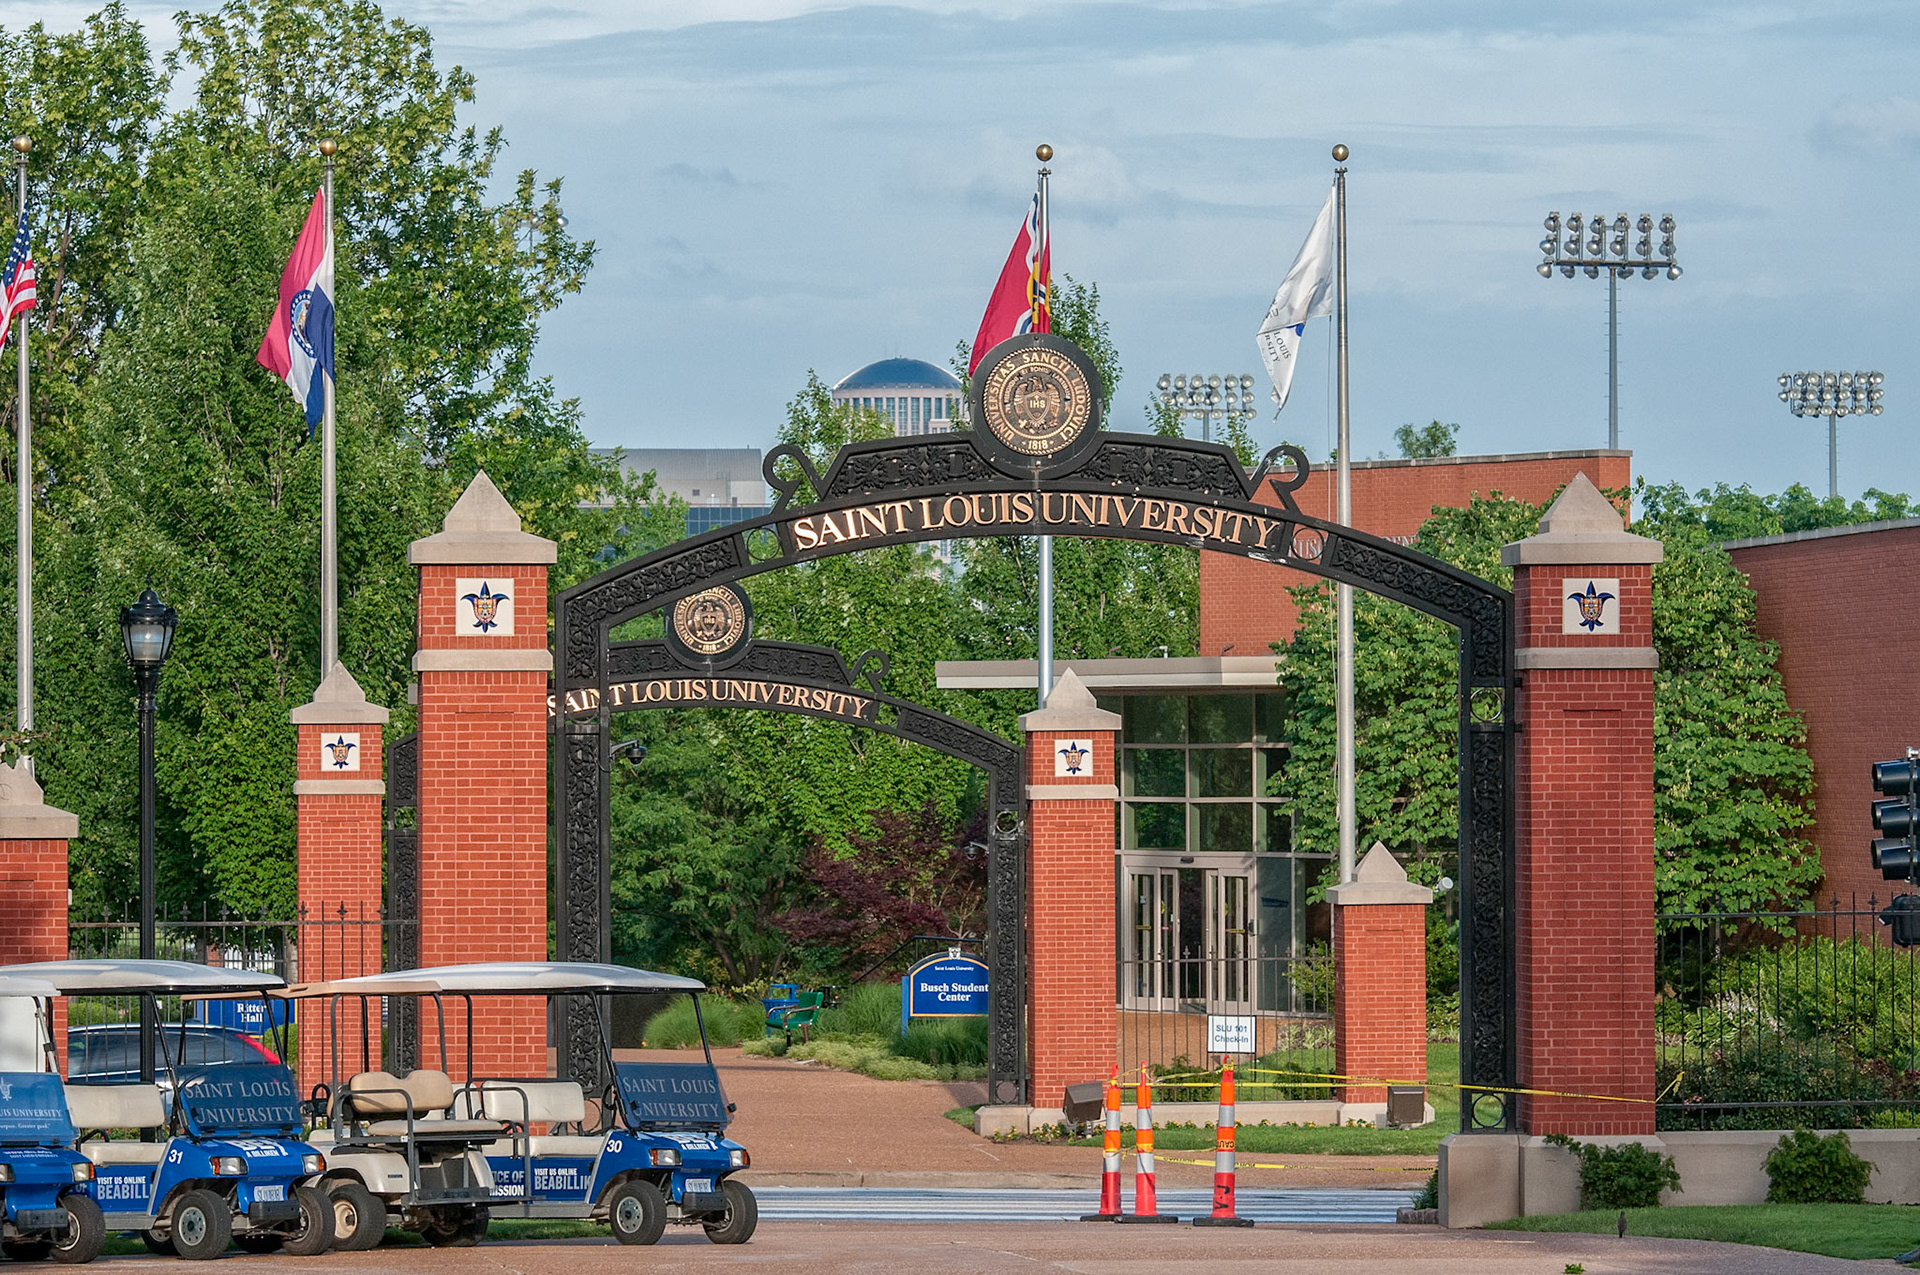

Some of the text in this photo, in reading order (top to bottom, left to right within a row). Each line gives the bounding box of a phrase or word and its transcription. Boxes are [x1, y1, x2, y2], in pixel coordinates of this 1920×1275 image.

[1264, 333, 1281, 362] RSITY
[1274, 331, 1291, 359] LOUIS
[988, 352, 1086, 441] UNIVERSITAS SANCTI LUDOVICI
[1029, 400, 1046, 409] IHS
[1027, 440, 1049, 450] 1818
[794, 492, 1280, 552] SAINT LOUIS UNIVERSITY
[724, 603, 742, 645] LUDOVICI
[631, 680, 707, 704] LOUIS
[711, 680, 869, 719] UNIVERSITY
[920, 982, 989, 992] Busch Student
[937, 992, 971, 1002] Center
[237, 1003, 266, 1013] Ritter
[241, 1013, 263, 1022] Hall
[1216, 1024, 1232, 1032] SLU
[1214, 1035, 1249, 1043] Check-In
[185, 1081, 291, 1098] SAINT LOUIS
[623, 1077, 716, 1094] SAINT LOUIS
[12, 1108, 61, 1117] UNIVERSITY
[197, 1106, 294, 1123] UNIVERSITY
[606, 1139, 623, 1153] 30
[168, 1149, 183, 1164] 31
[492, 1170, 525, 1183] ICE OF
[534, 1168, 548, 1176] VISIT
[97, 1176, 146, 1185] VISIT US ONLINE
[97, 1184, 149, 1200] BEABILL
